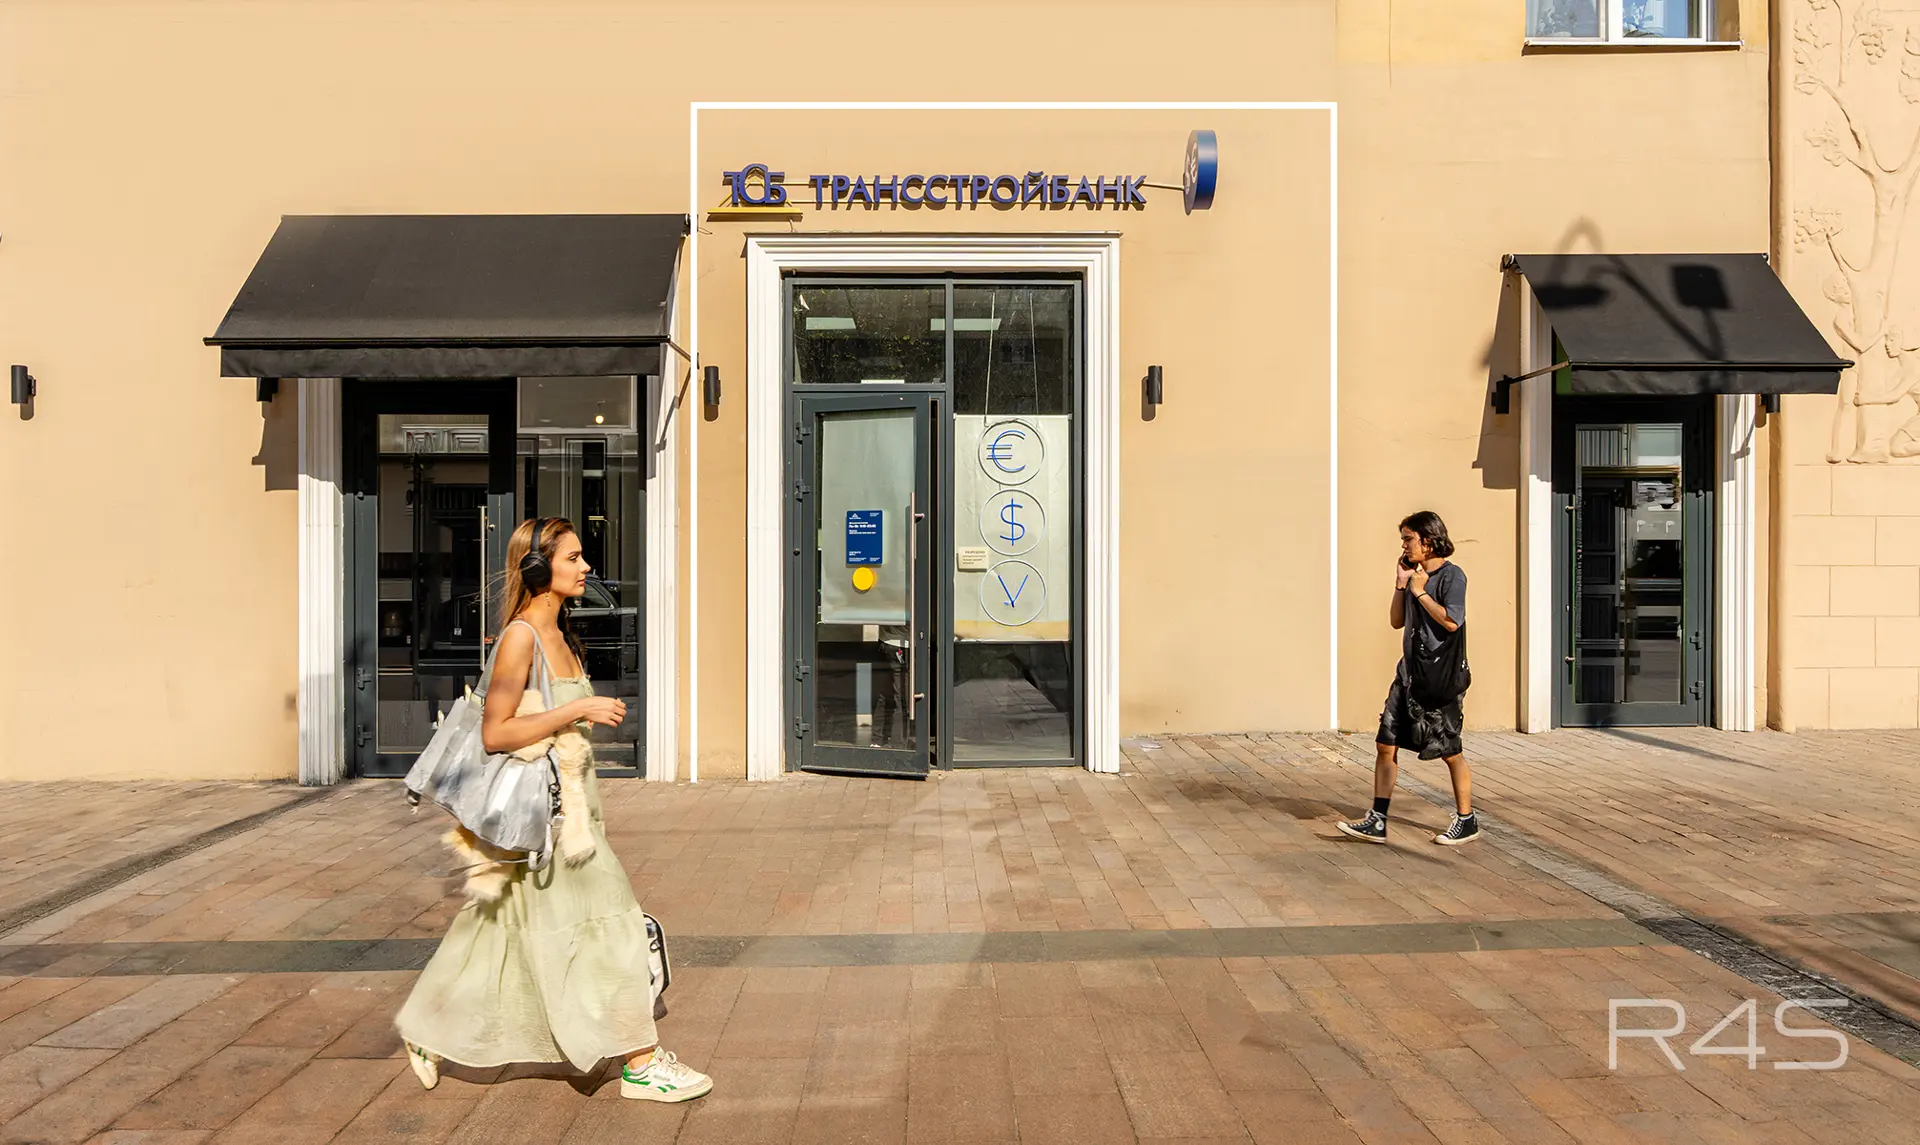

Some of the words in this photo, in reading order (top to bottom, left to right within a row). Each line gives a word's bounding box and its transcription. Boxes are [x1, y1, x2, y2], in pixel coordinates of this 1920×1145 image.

[723, 164, 787, 204] ТСБ
[809, 171, 1147, 204] ТРАНССТРОЙБАНК
[1000, 498, 1026, 546] $
